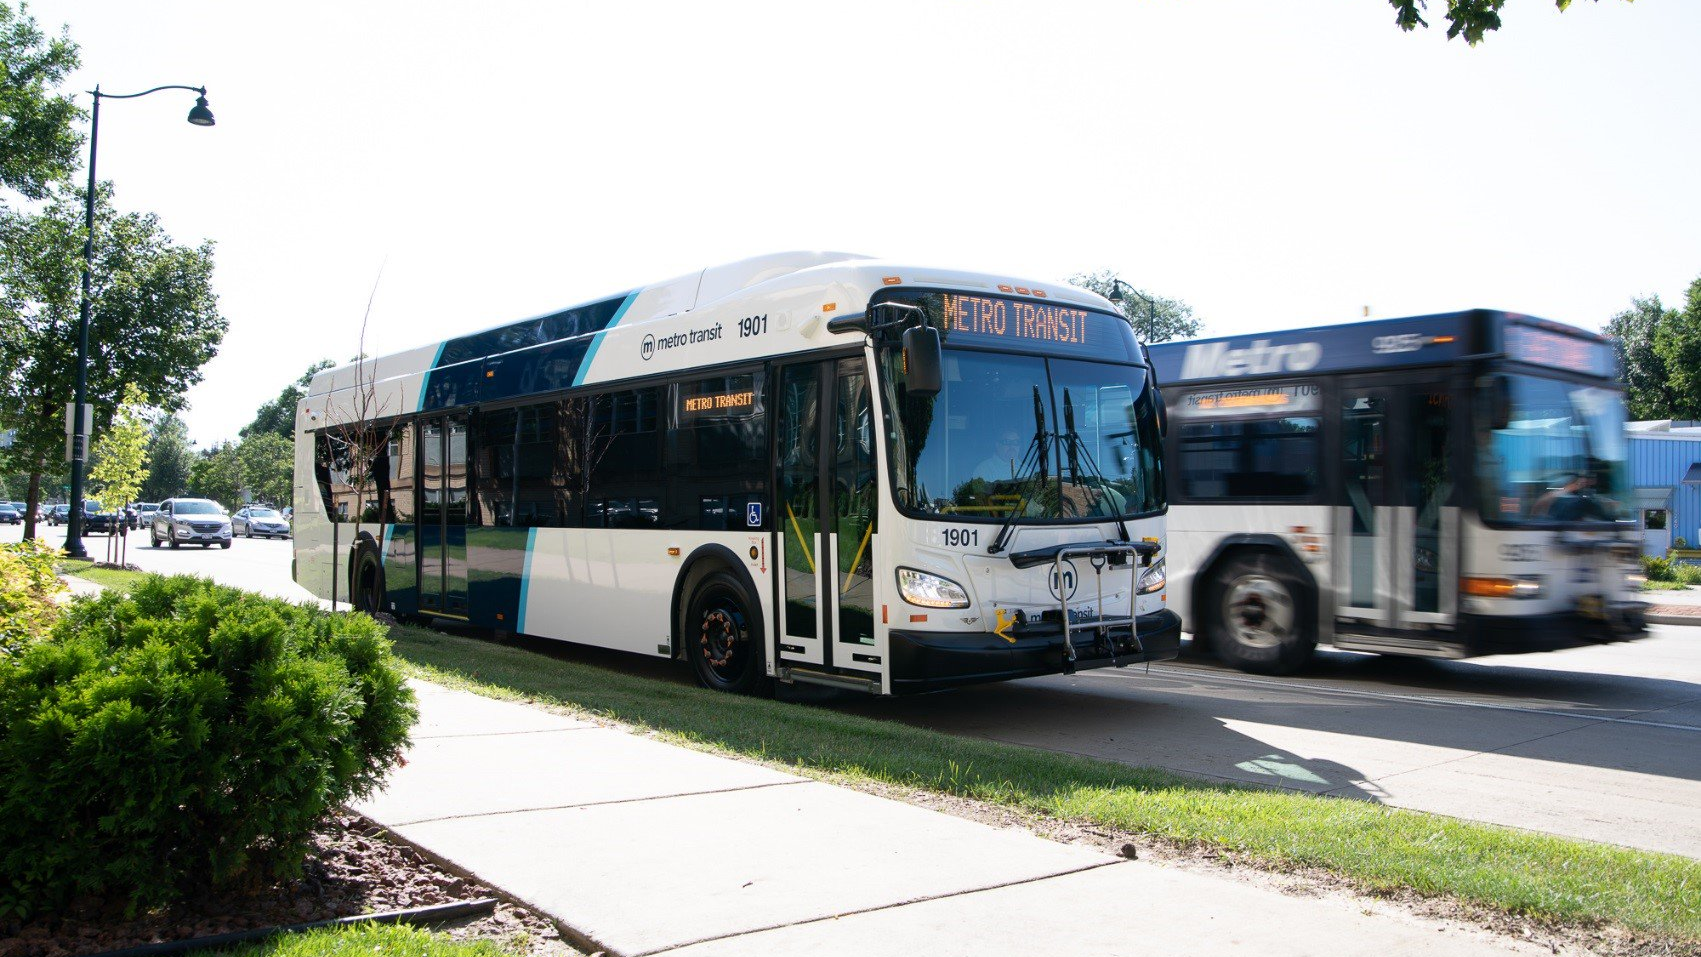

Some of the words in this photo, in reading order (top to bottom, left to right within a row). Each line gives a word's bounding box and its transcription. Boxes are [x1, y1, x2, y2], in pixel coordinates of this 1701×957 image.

[738, 314, 768, 338] 1901
[943, 294, 1006, 335] METRO
[1013, 303, 1088, 344] TRANSIT
[657, 332, 687, 350] metro
[689, 322, 722, 344] transit
[1180, 339, 1324, 380] Metro
[686, 396, 713, 411] METRO
[715, 392, 753, 408] TRANSIT
[942, 528, 978, 546] 1901
